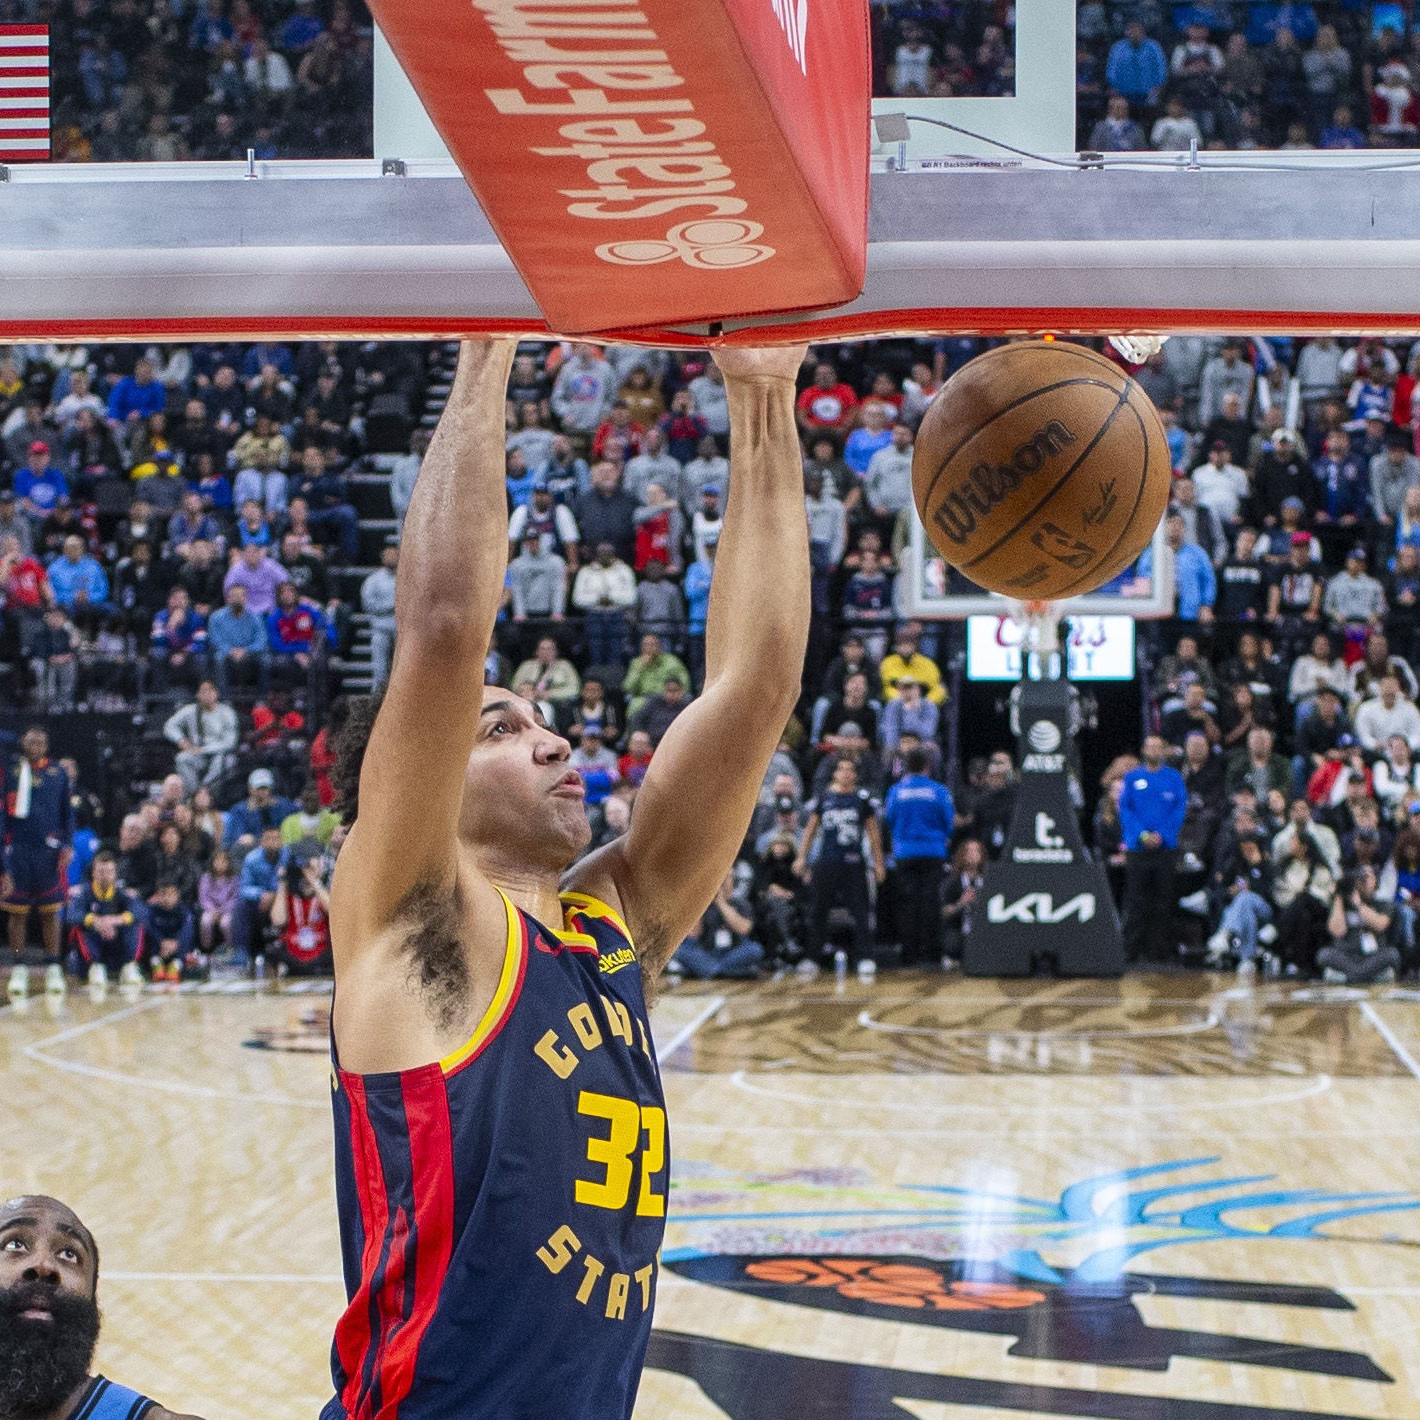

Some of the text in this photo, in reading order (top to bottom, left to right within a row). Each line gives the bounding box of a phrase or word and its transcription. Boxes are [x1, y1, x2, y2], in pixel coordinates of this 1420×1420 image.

[933, 419, 1078, 545] Wilson
[1022, 753, 1066, 774] AT&T
[987, 892, 1096, 924] KIA
[597, 947, 636, 974] akuten
[574, 1090, 666, 1218] 32
[535, 1223, 663, 1322] STAT
